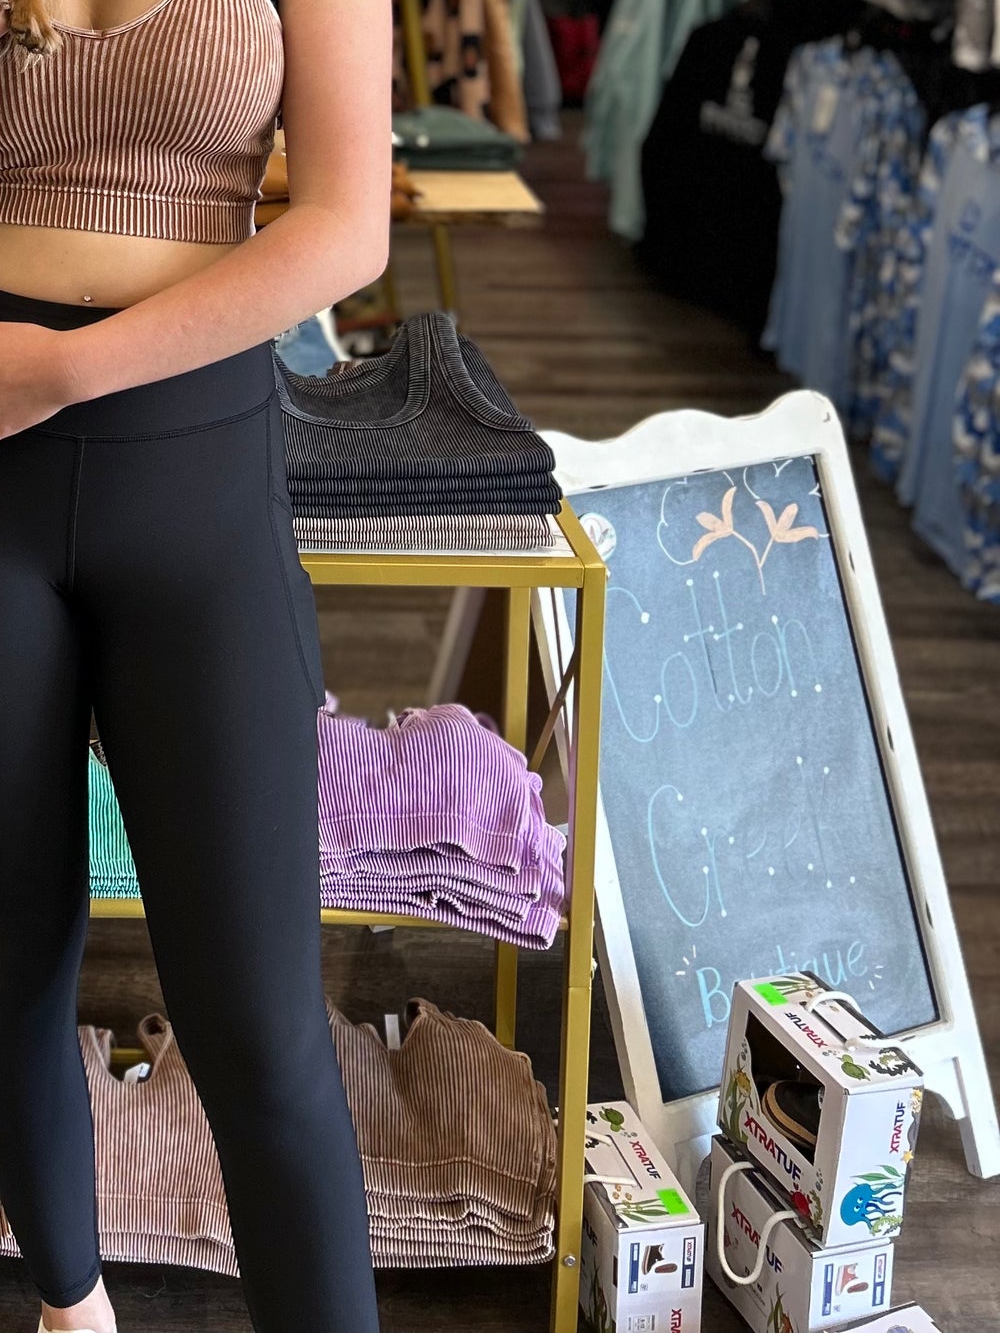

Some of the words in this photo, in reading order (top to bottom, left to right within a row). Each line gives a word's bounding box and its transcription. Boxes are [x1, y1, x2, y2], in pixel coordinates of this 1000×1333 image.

[600, 570, 823, 742] Cotton
[784, 1011, 829, 1048] XTRATUF
[744, 1110, 803, 1181] XTRATUF
[888, 1101, 906, 1154] XTRATUF
[629, 1140, 662, 1180] XTRATUF
[731, 1201, 783, 1274] XTRAUF
